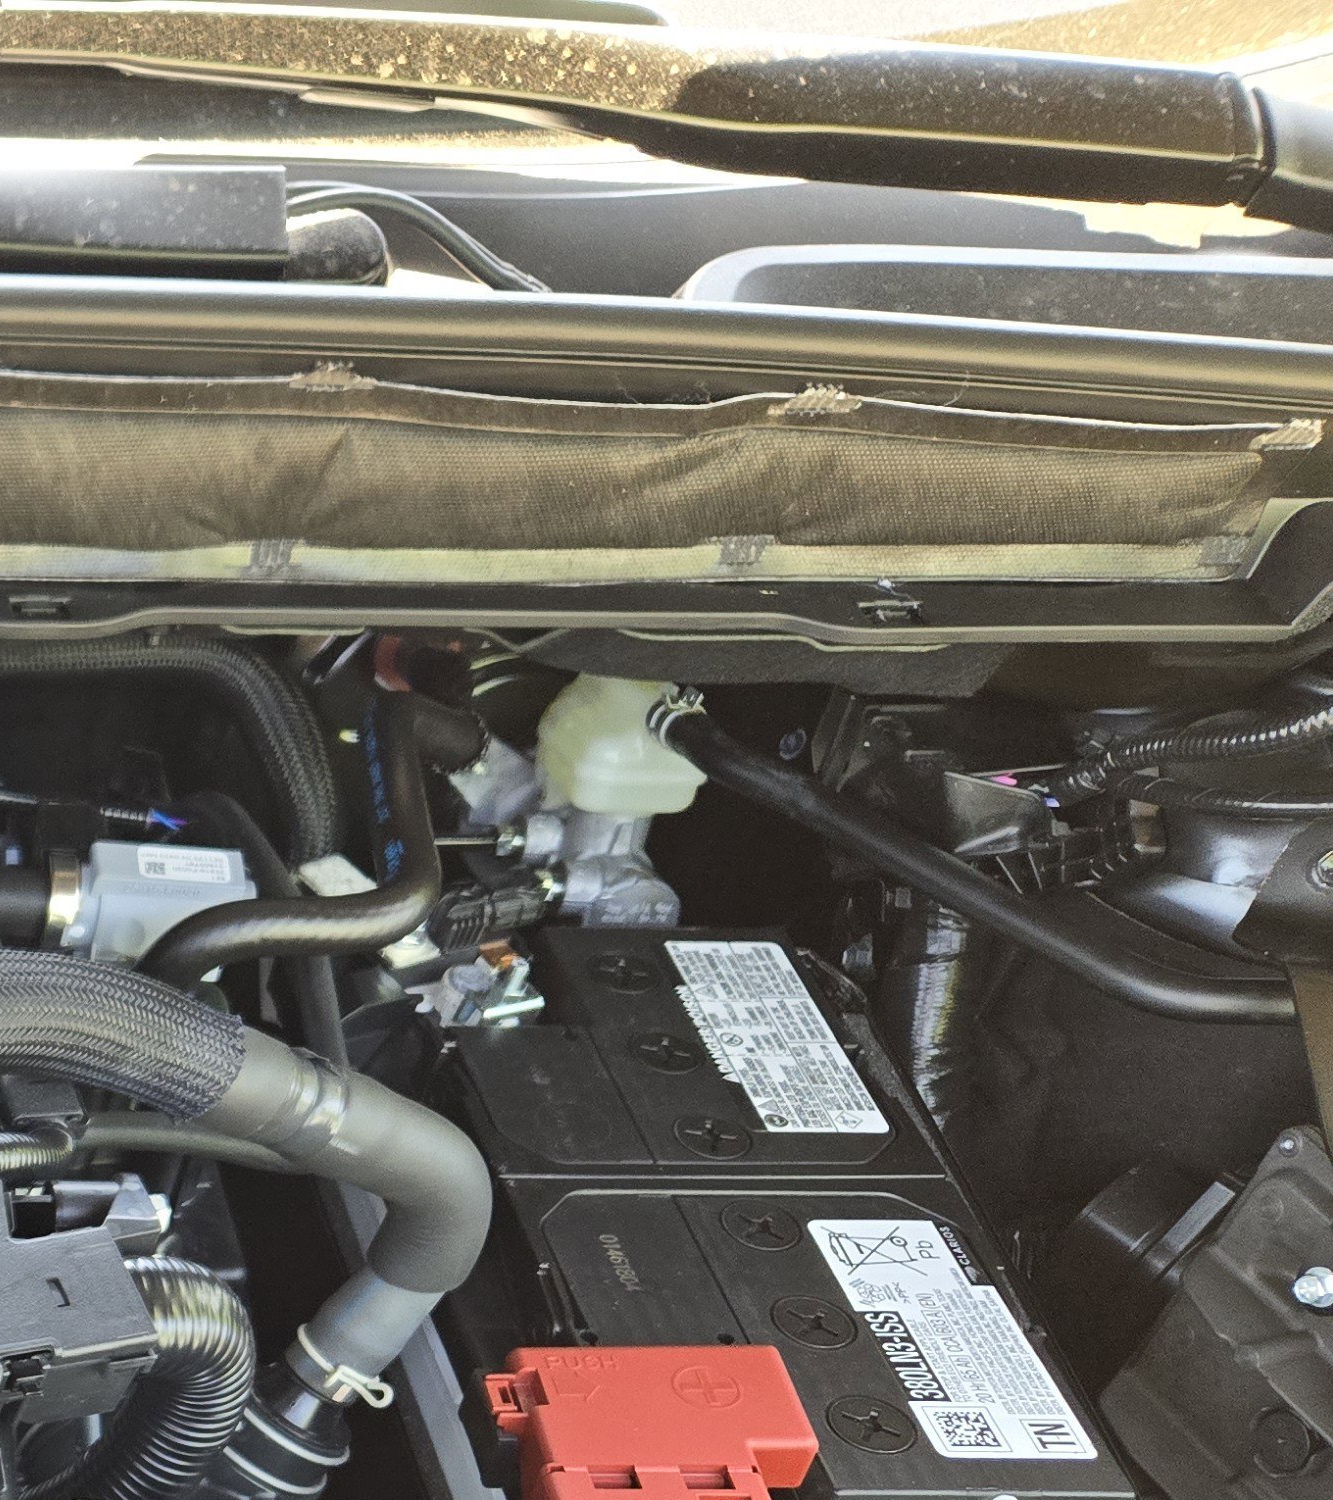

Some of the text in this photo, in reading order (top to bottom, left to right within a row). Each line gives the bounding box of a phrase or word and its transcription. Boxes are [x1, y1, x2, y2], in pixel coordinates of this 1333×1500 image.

[915, 1240, 940, 1260] Pb
[939, 1225, 970, 1267] CLARIOS
[544, 1353, 620, 1371] PUSH
[864, 1312, 945, 1400] 380LN3-ISS
